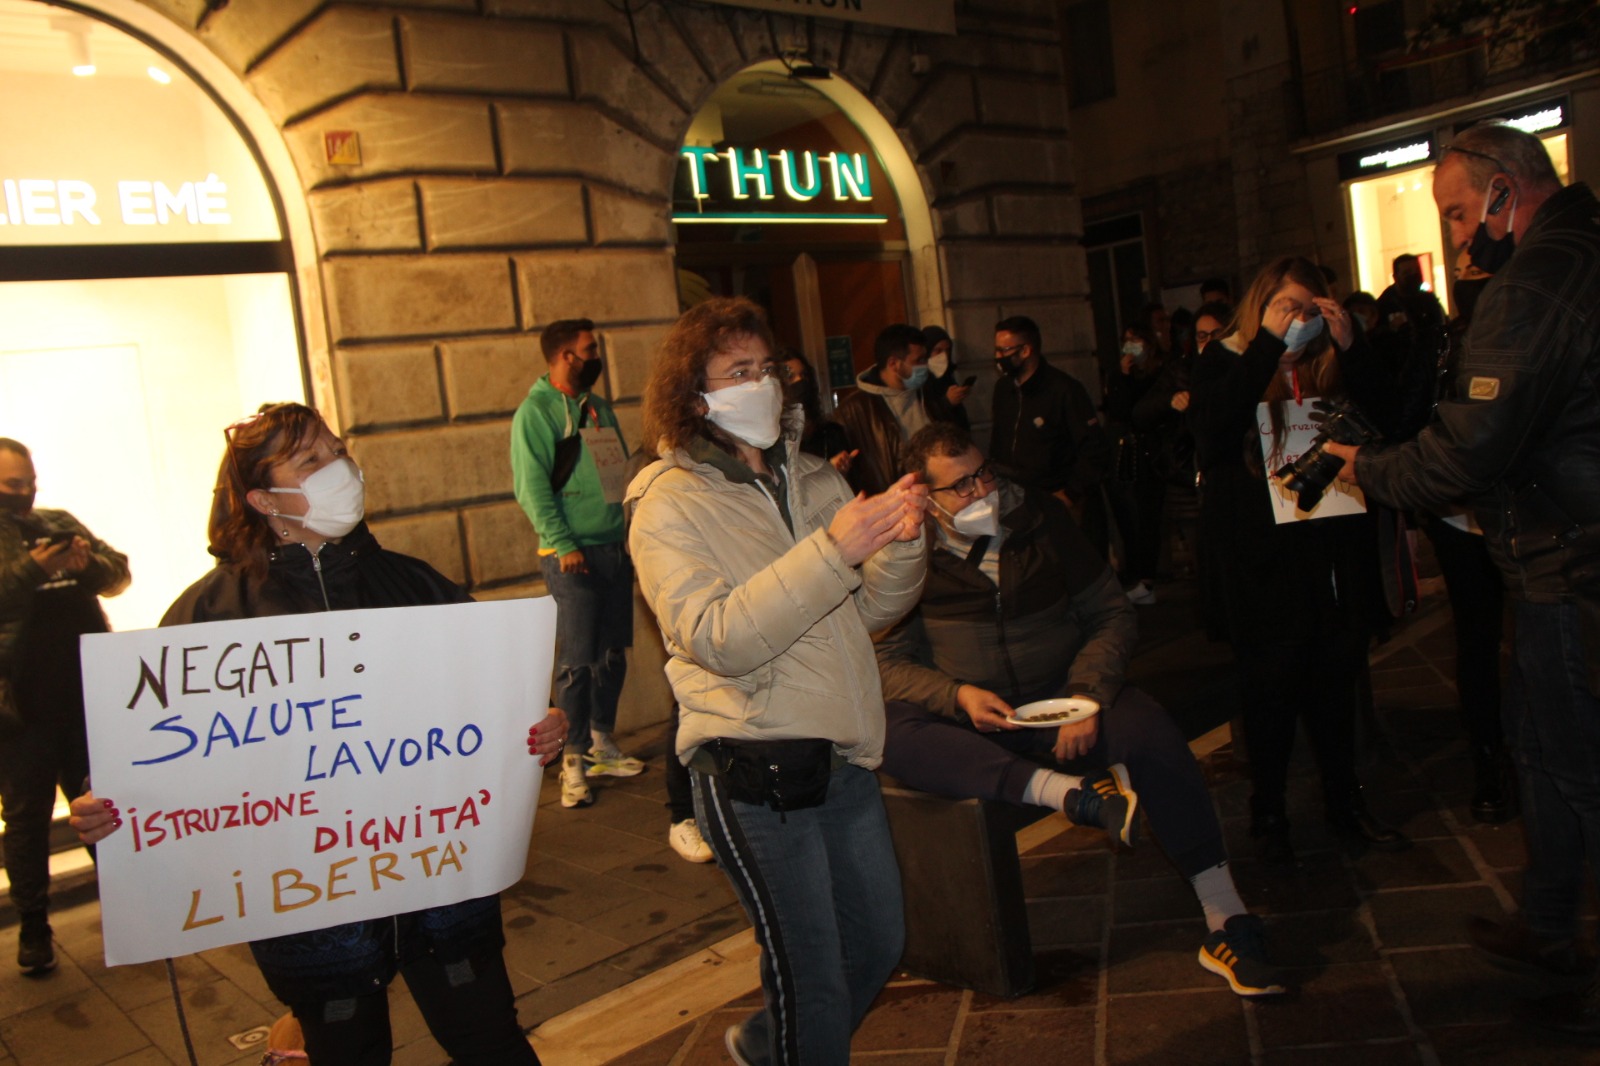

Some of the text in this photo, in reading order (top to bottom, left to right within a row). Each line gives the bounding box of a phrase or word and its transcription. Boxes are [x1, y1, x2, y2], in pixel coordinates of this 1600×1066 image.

[0, 172, 232, 226] IER EMÉ
[680, 146, 873, 201] THUN
[131, 693, 363, 767] SALUTE
[303, 723, 483, 782] LAVORO
